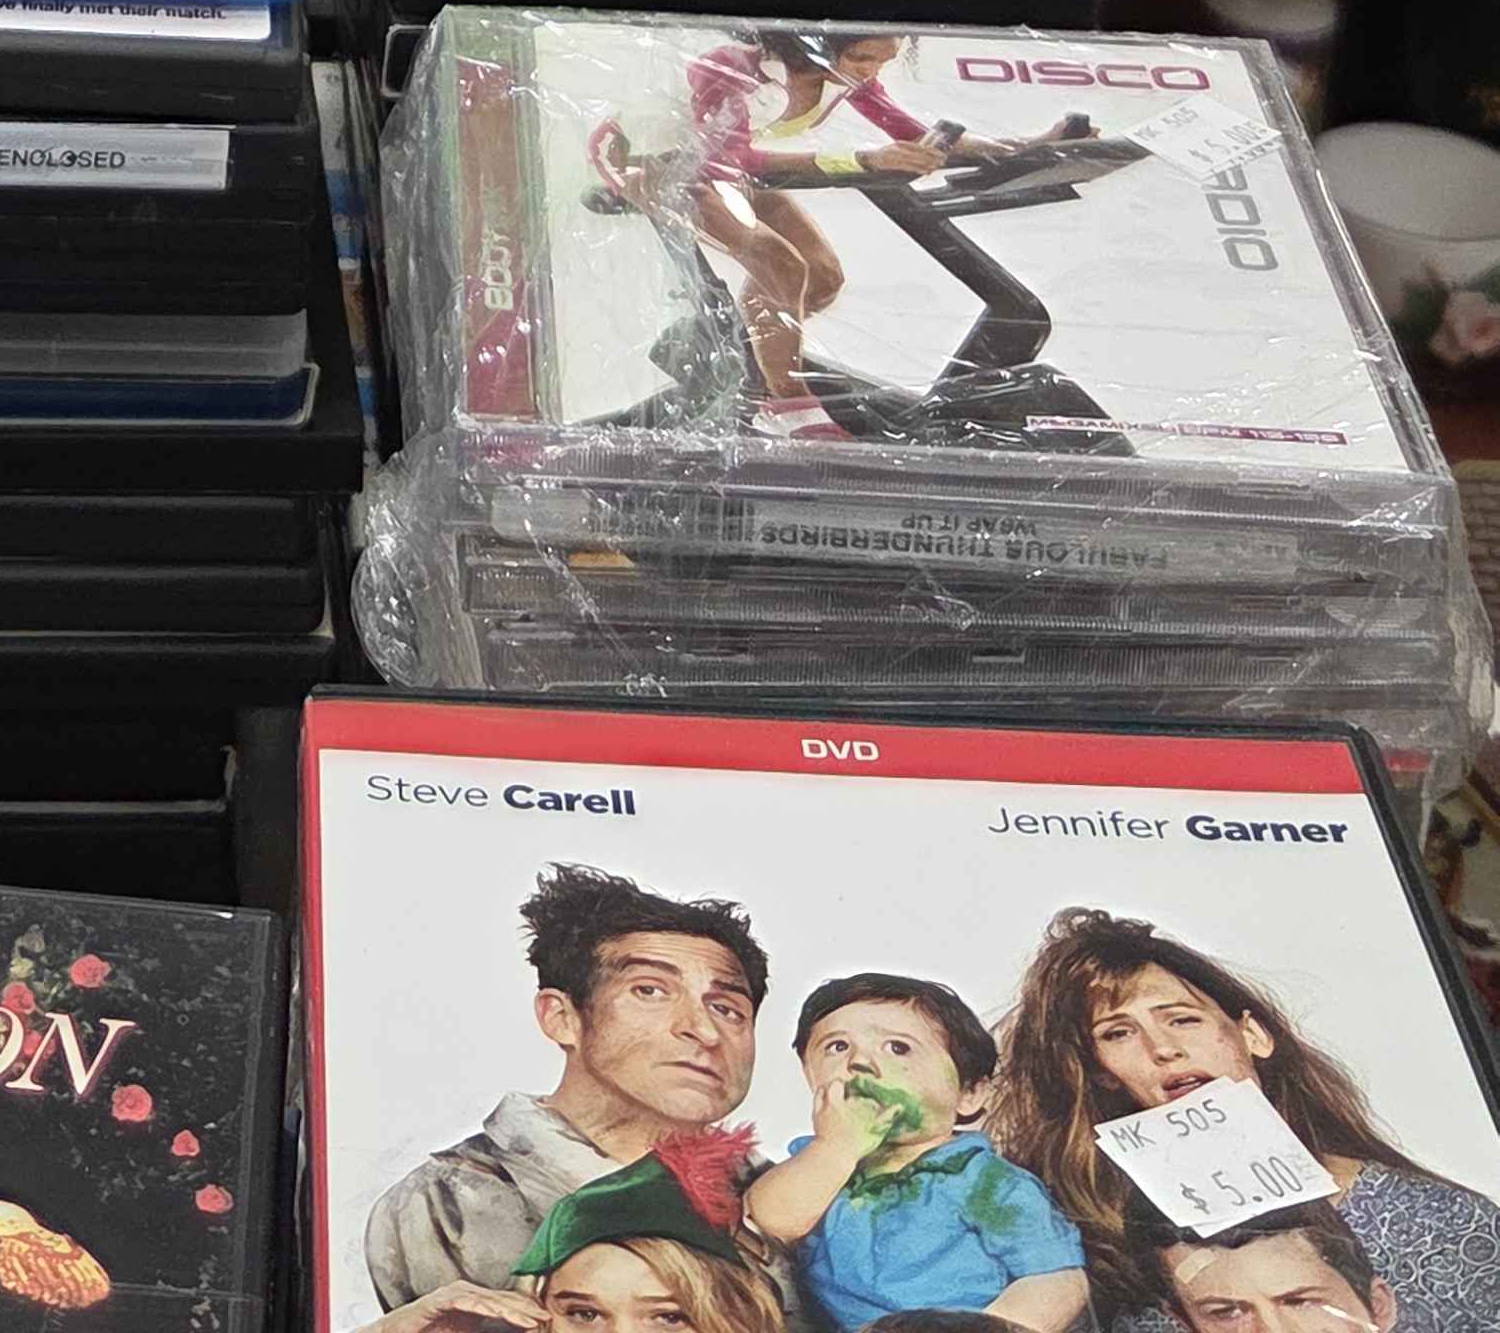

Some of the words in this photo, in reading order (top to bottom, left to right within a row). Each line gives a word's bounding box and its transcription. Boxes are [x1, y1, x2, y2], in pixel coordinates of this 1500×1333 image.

[79, 3, 115, 15] met
[118, 3, 160, 17] their
[955, 57, 1211, 91] DISCO
[900, 513, 935, 531] UP
[761, 523, 995, 563] THUNDERBIRDS
[801, 739, 879, 760] DVD
[367, 775, 488, 807] Steve
[503, 784, 636, 815] Carell
[988, 807, 1170, 840] Jennifer
[1185, 814, 1349, 843] Garner
[1109, 1120, 1157, 1153] MK
[1165, 1098, 1228, 1138] 505
